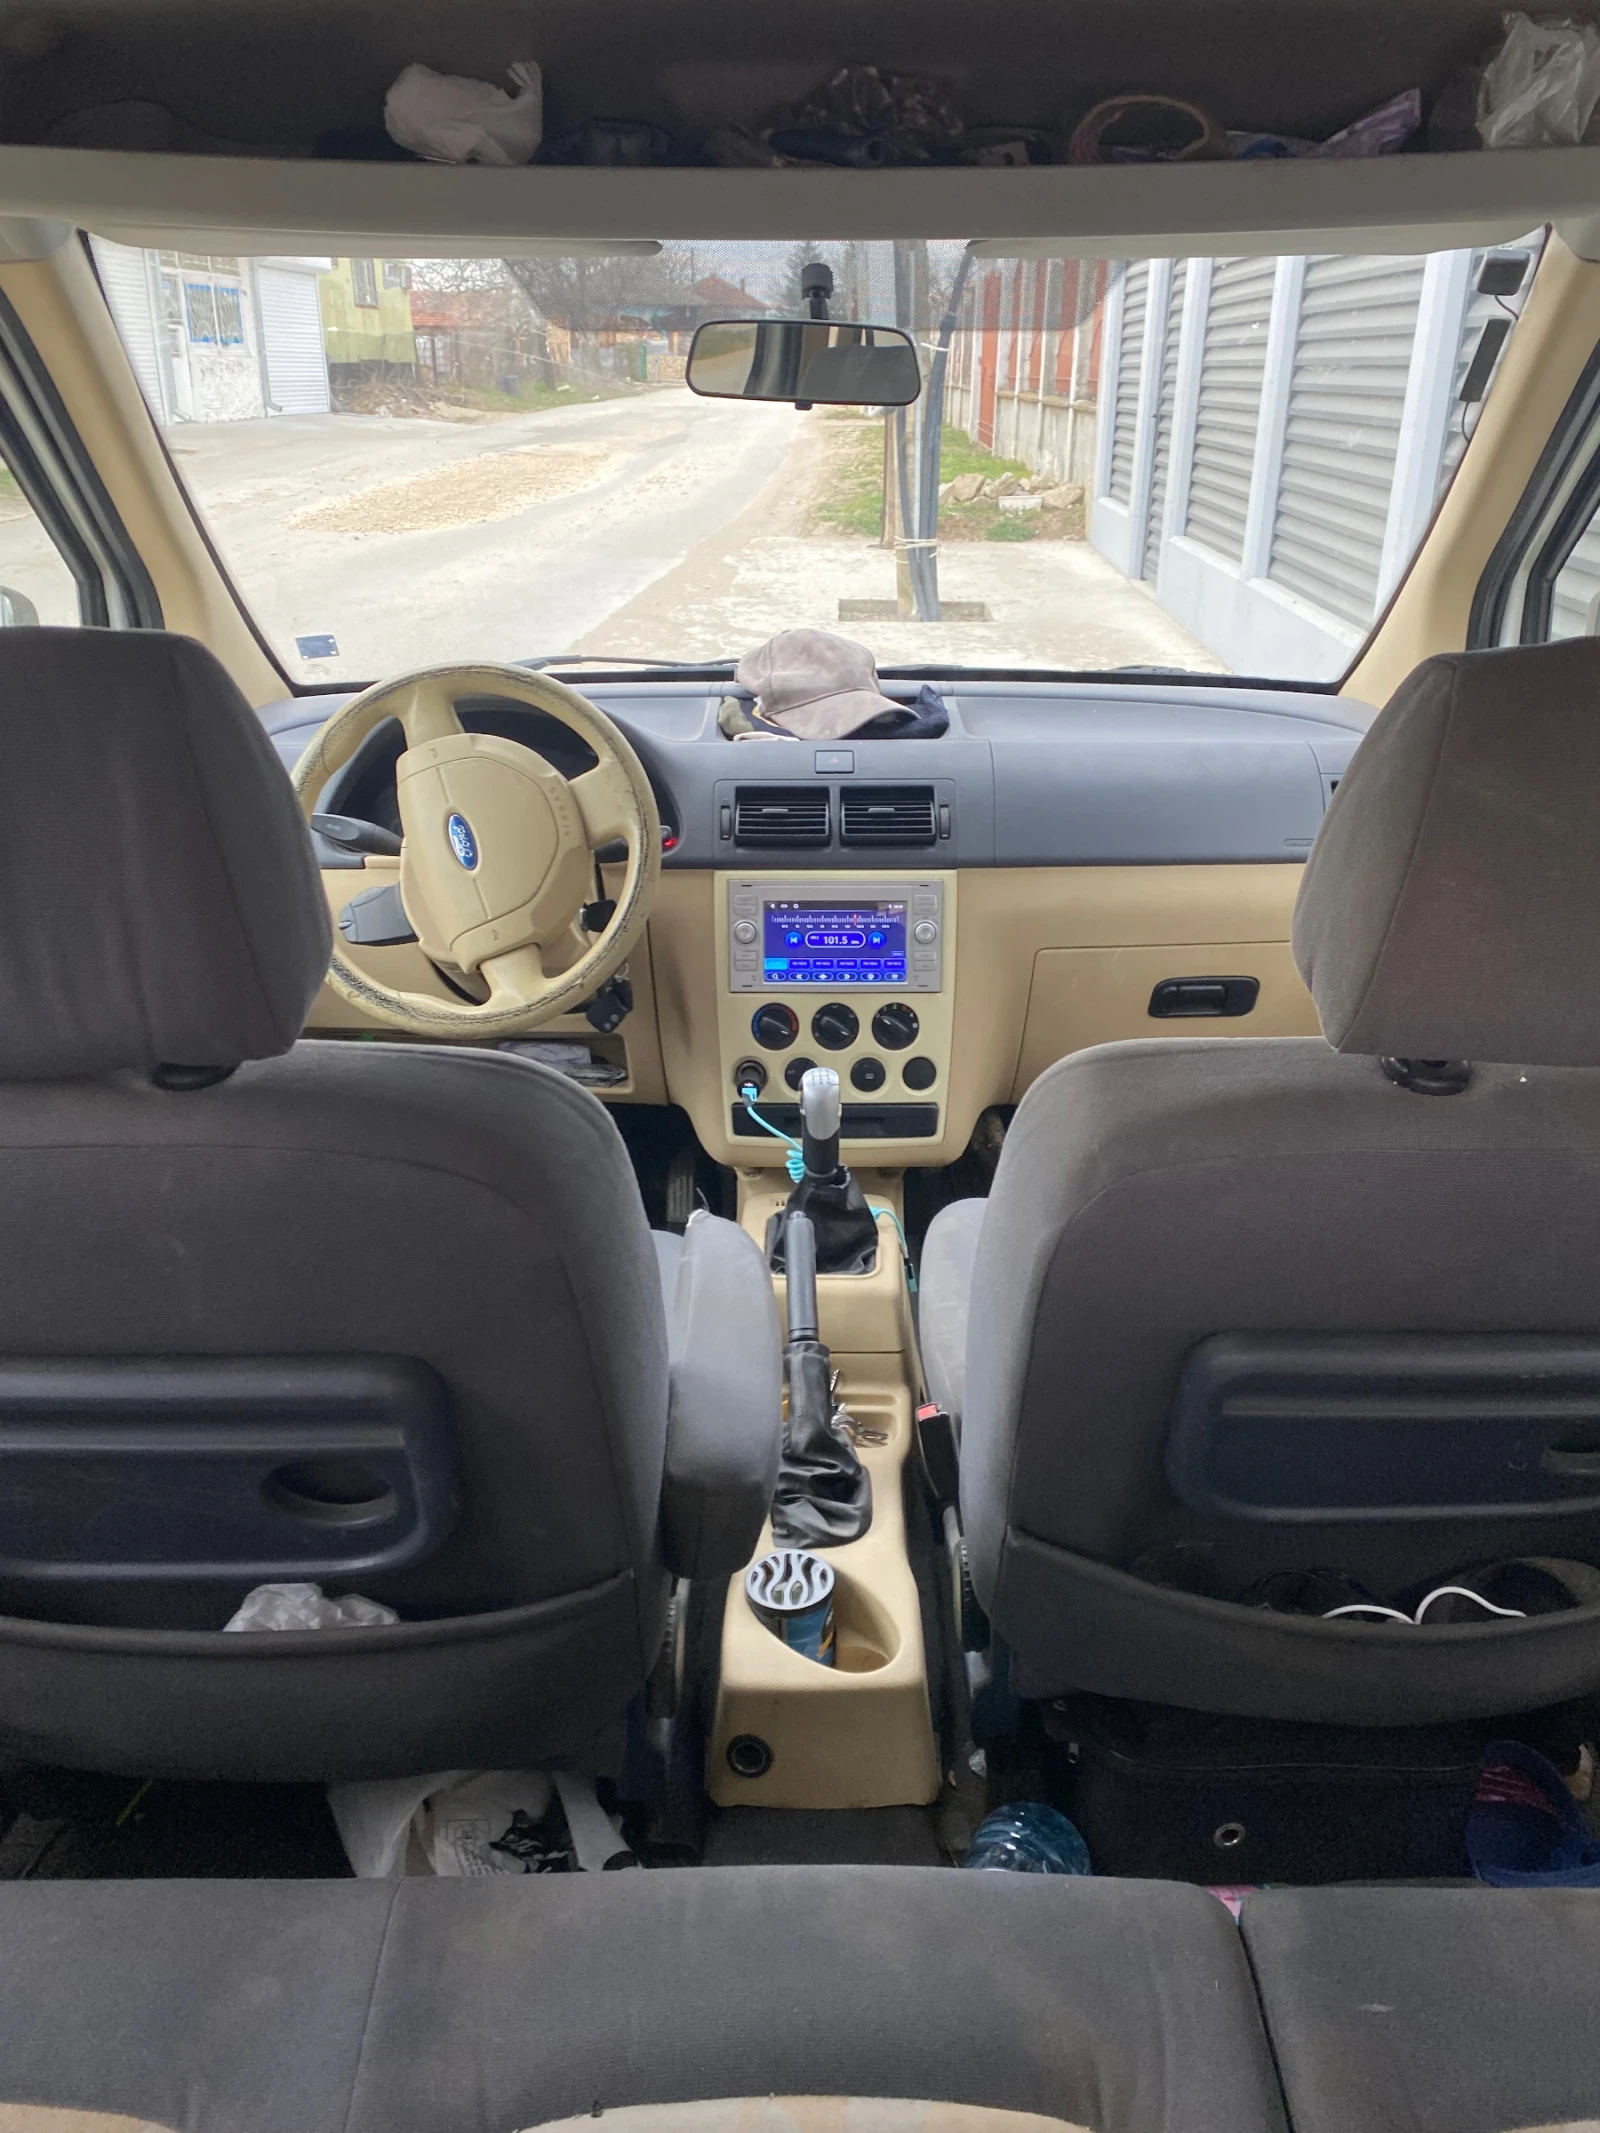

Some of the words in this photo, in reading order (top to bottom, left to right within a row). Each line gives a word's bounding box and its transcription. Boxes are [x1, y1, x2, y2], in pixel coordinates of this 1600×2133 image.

[549, 787, 572, 836] AIRBAG
[452, 824, 473, 858] Ford
[823, 935, 848, 945] 101.5
